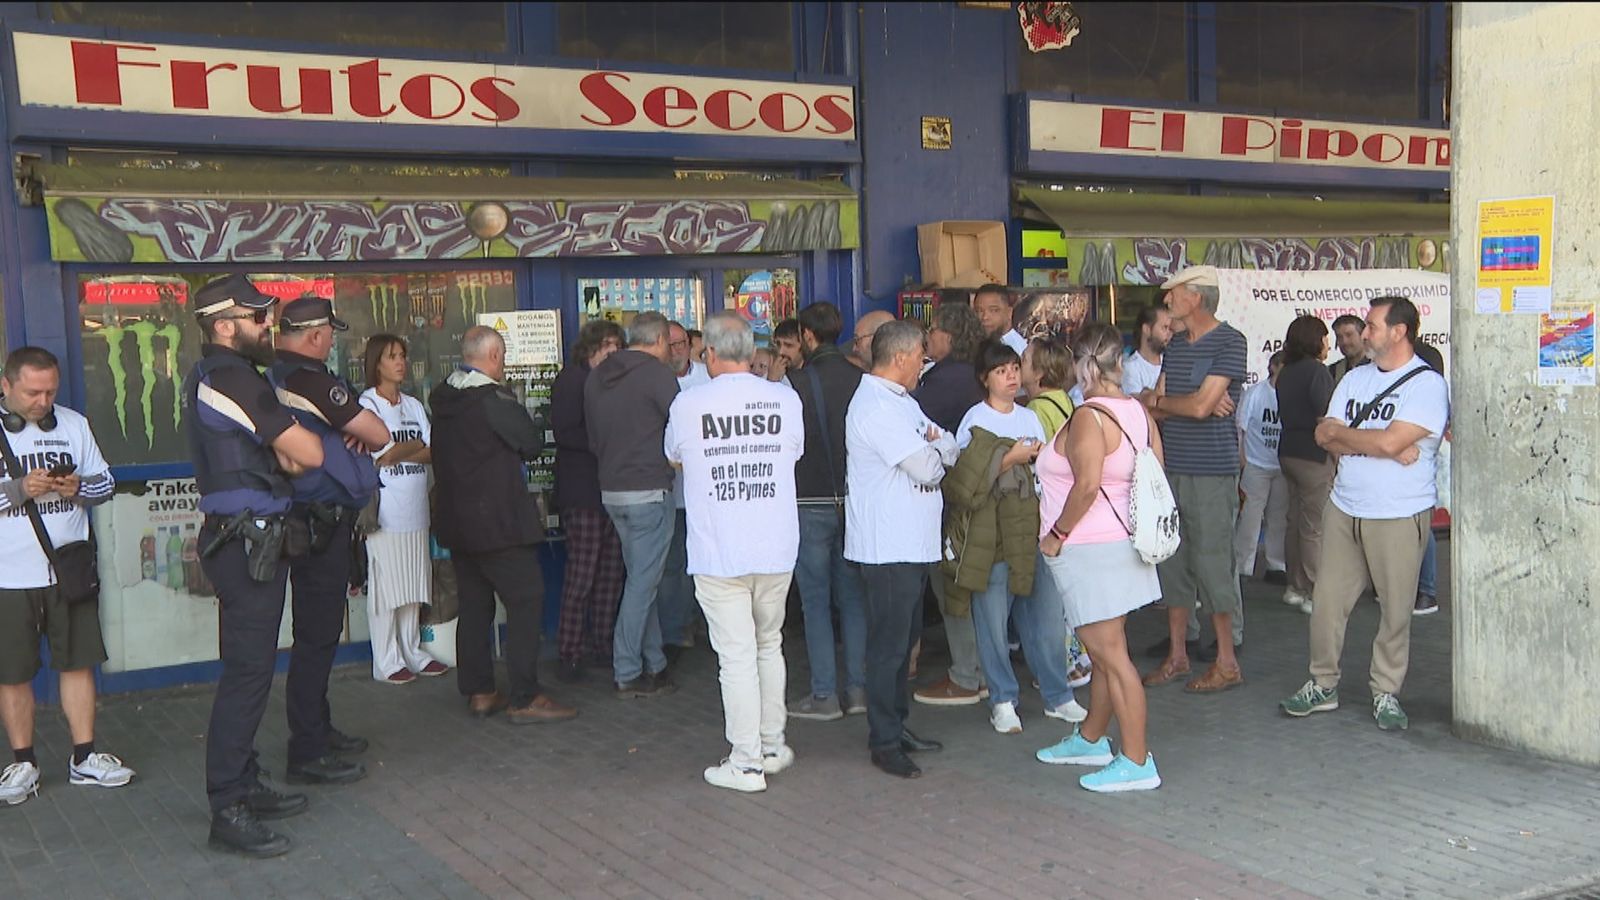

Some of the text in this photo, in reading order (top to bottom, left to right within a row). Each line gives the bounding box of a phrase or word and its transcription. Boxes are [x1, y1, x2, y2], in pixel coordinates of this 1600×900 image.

[70, 40, 854, 134] Frutos Secos
[1100, 107, 1186, 153] El
[1252, 288, 1278, 301] POR
[1280, 289, 1295, 301] EL
[1296, 288, 1363, 301] COMERCIO
[1385, 284, 1450, 298] PROXIMID
[702, 413, 782, 440] Ayuso
[704, 443, 782, 458] extermina el comercio
[711, 461, 773, 481] en el metro
[152, 481, 199, 496] Take
[714, 483, 736, 501] 125
[738, 481, 776, 501] Pymes
[148, 498, 199, 512] away
